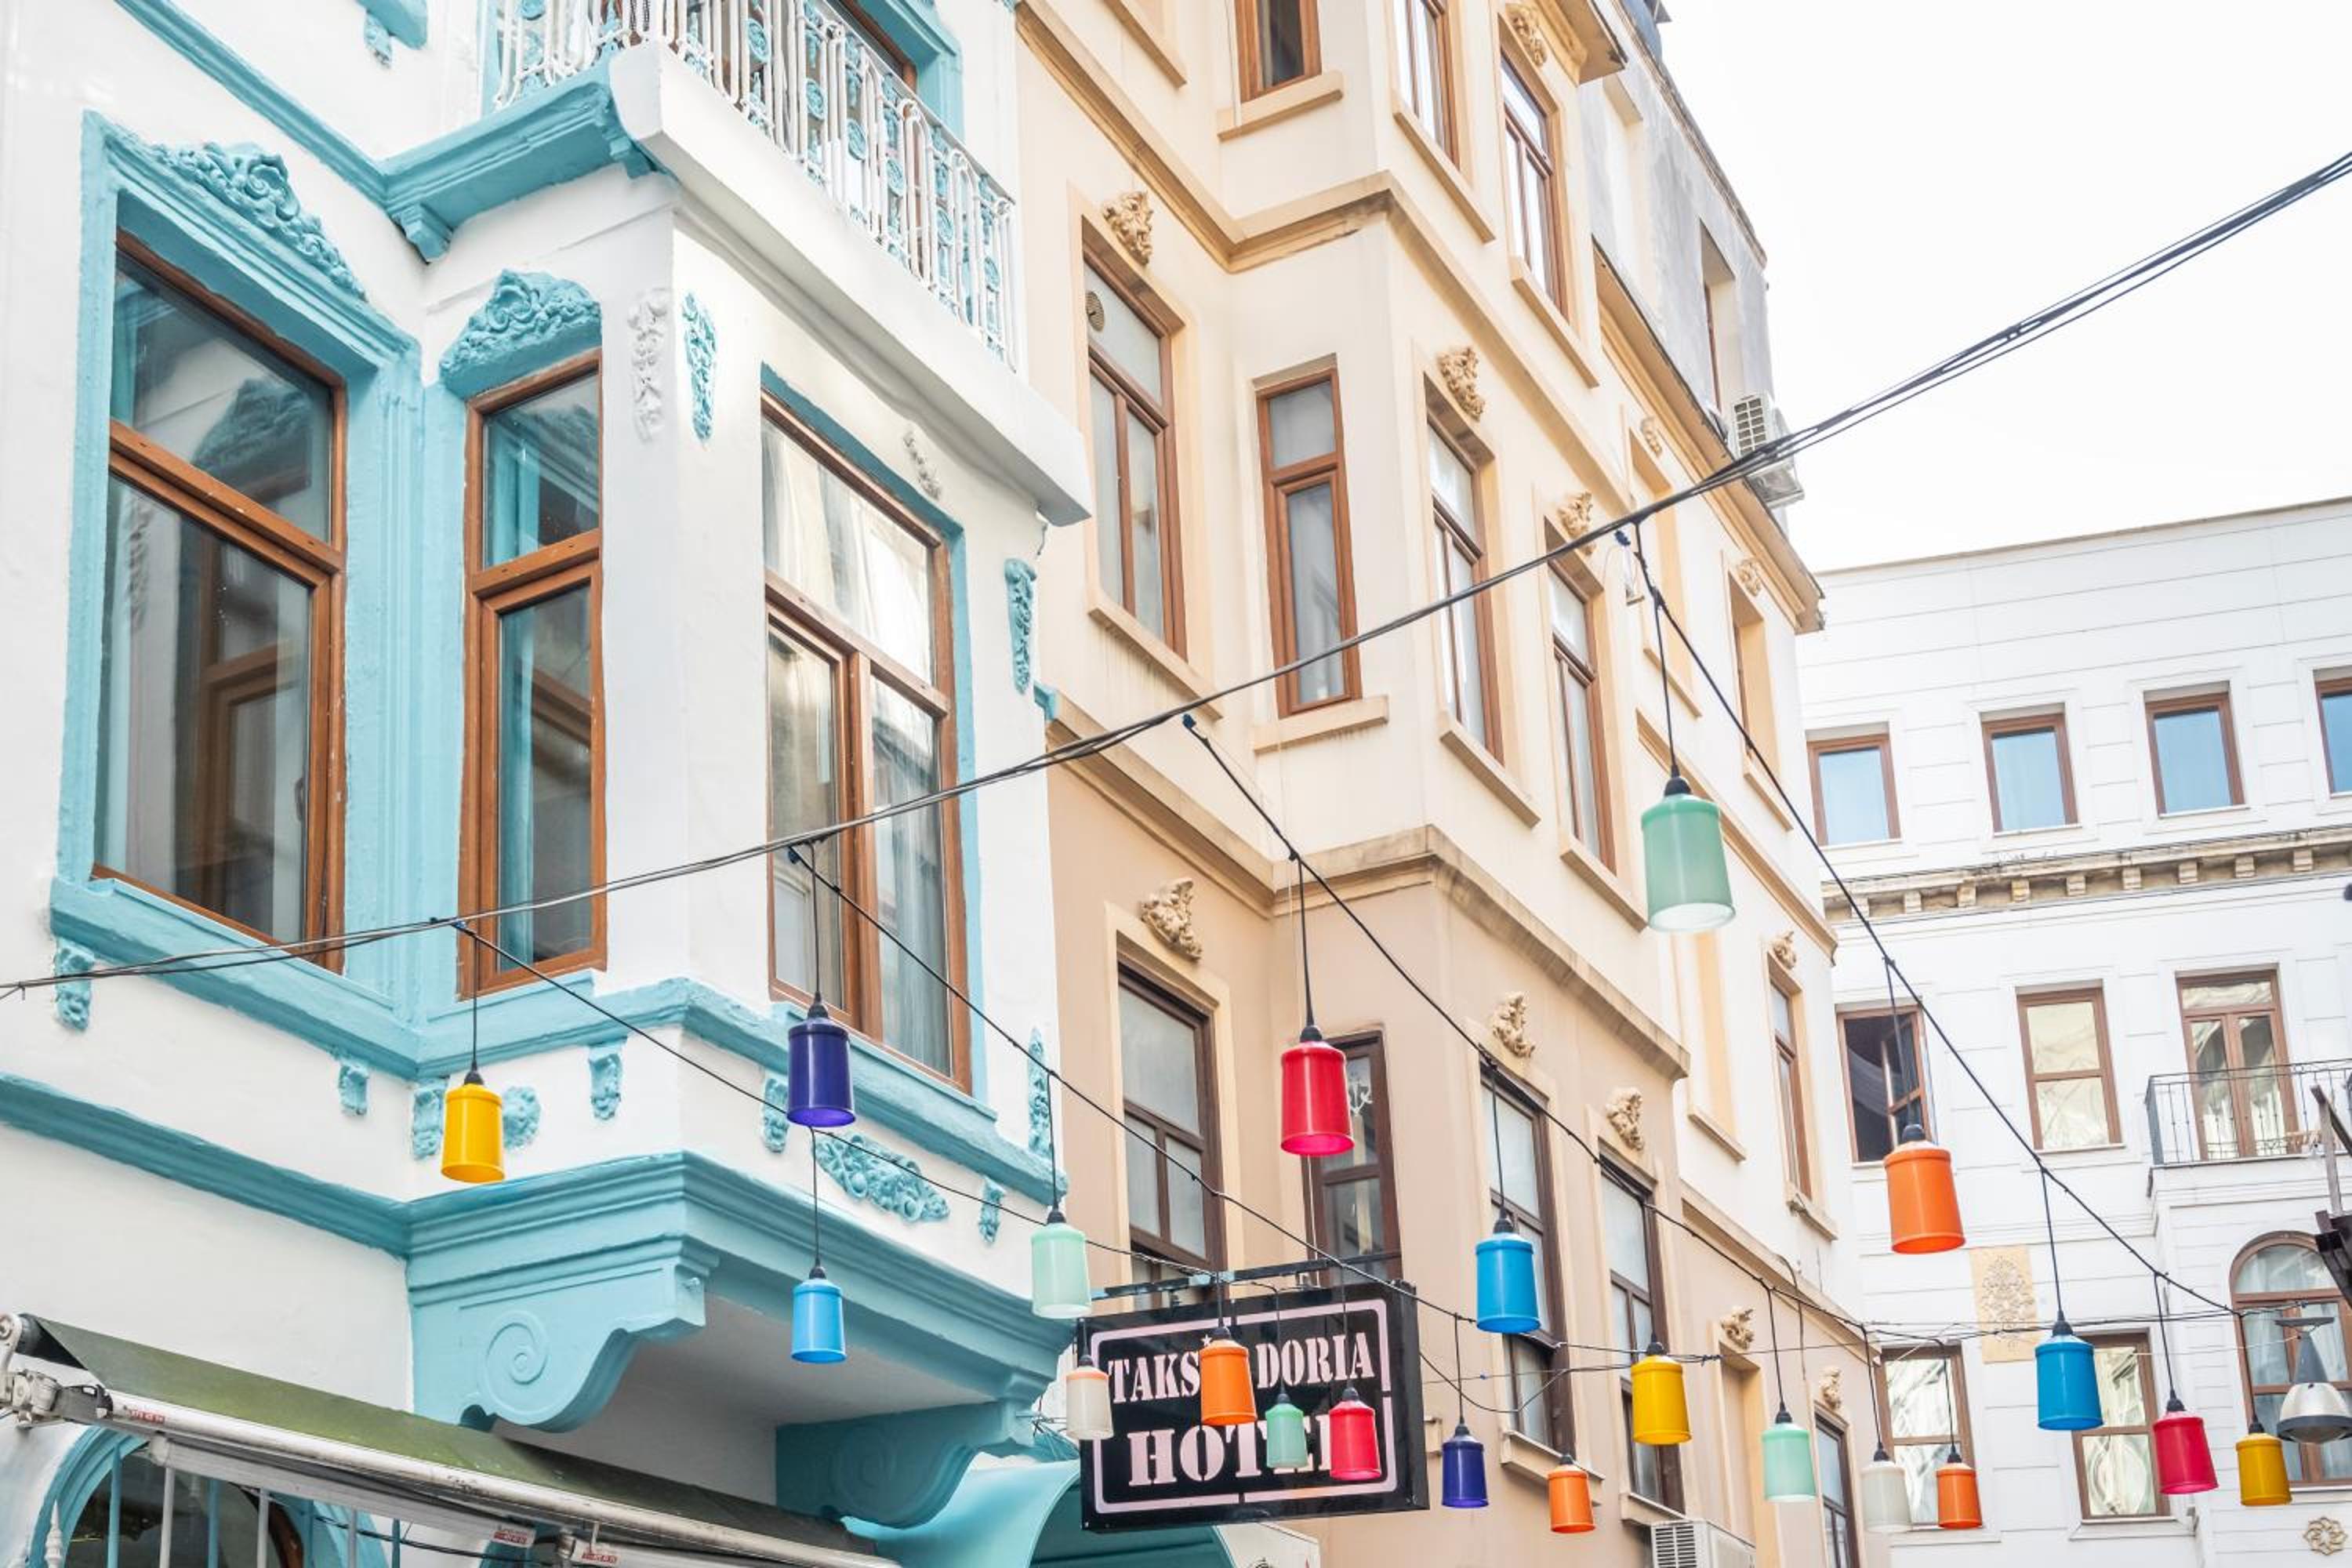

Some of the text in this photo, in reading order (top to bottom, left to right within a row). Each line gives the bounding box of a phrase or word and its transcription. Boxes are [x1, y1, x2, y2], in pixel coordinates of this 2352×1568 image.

[1108, 1332, 1374, 1403] TAKS DORIA
[1128, 1414, 1331, 1486] HOT
